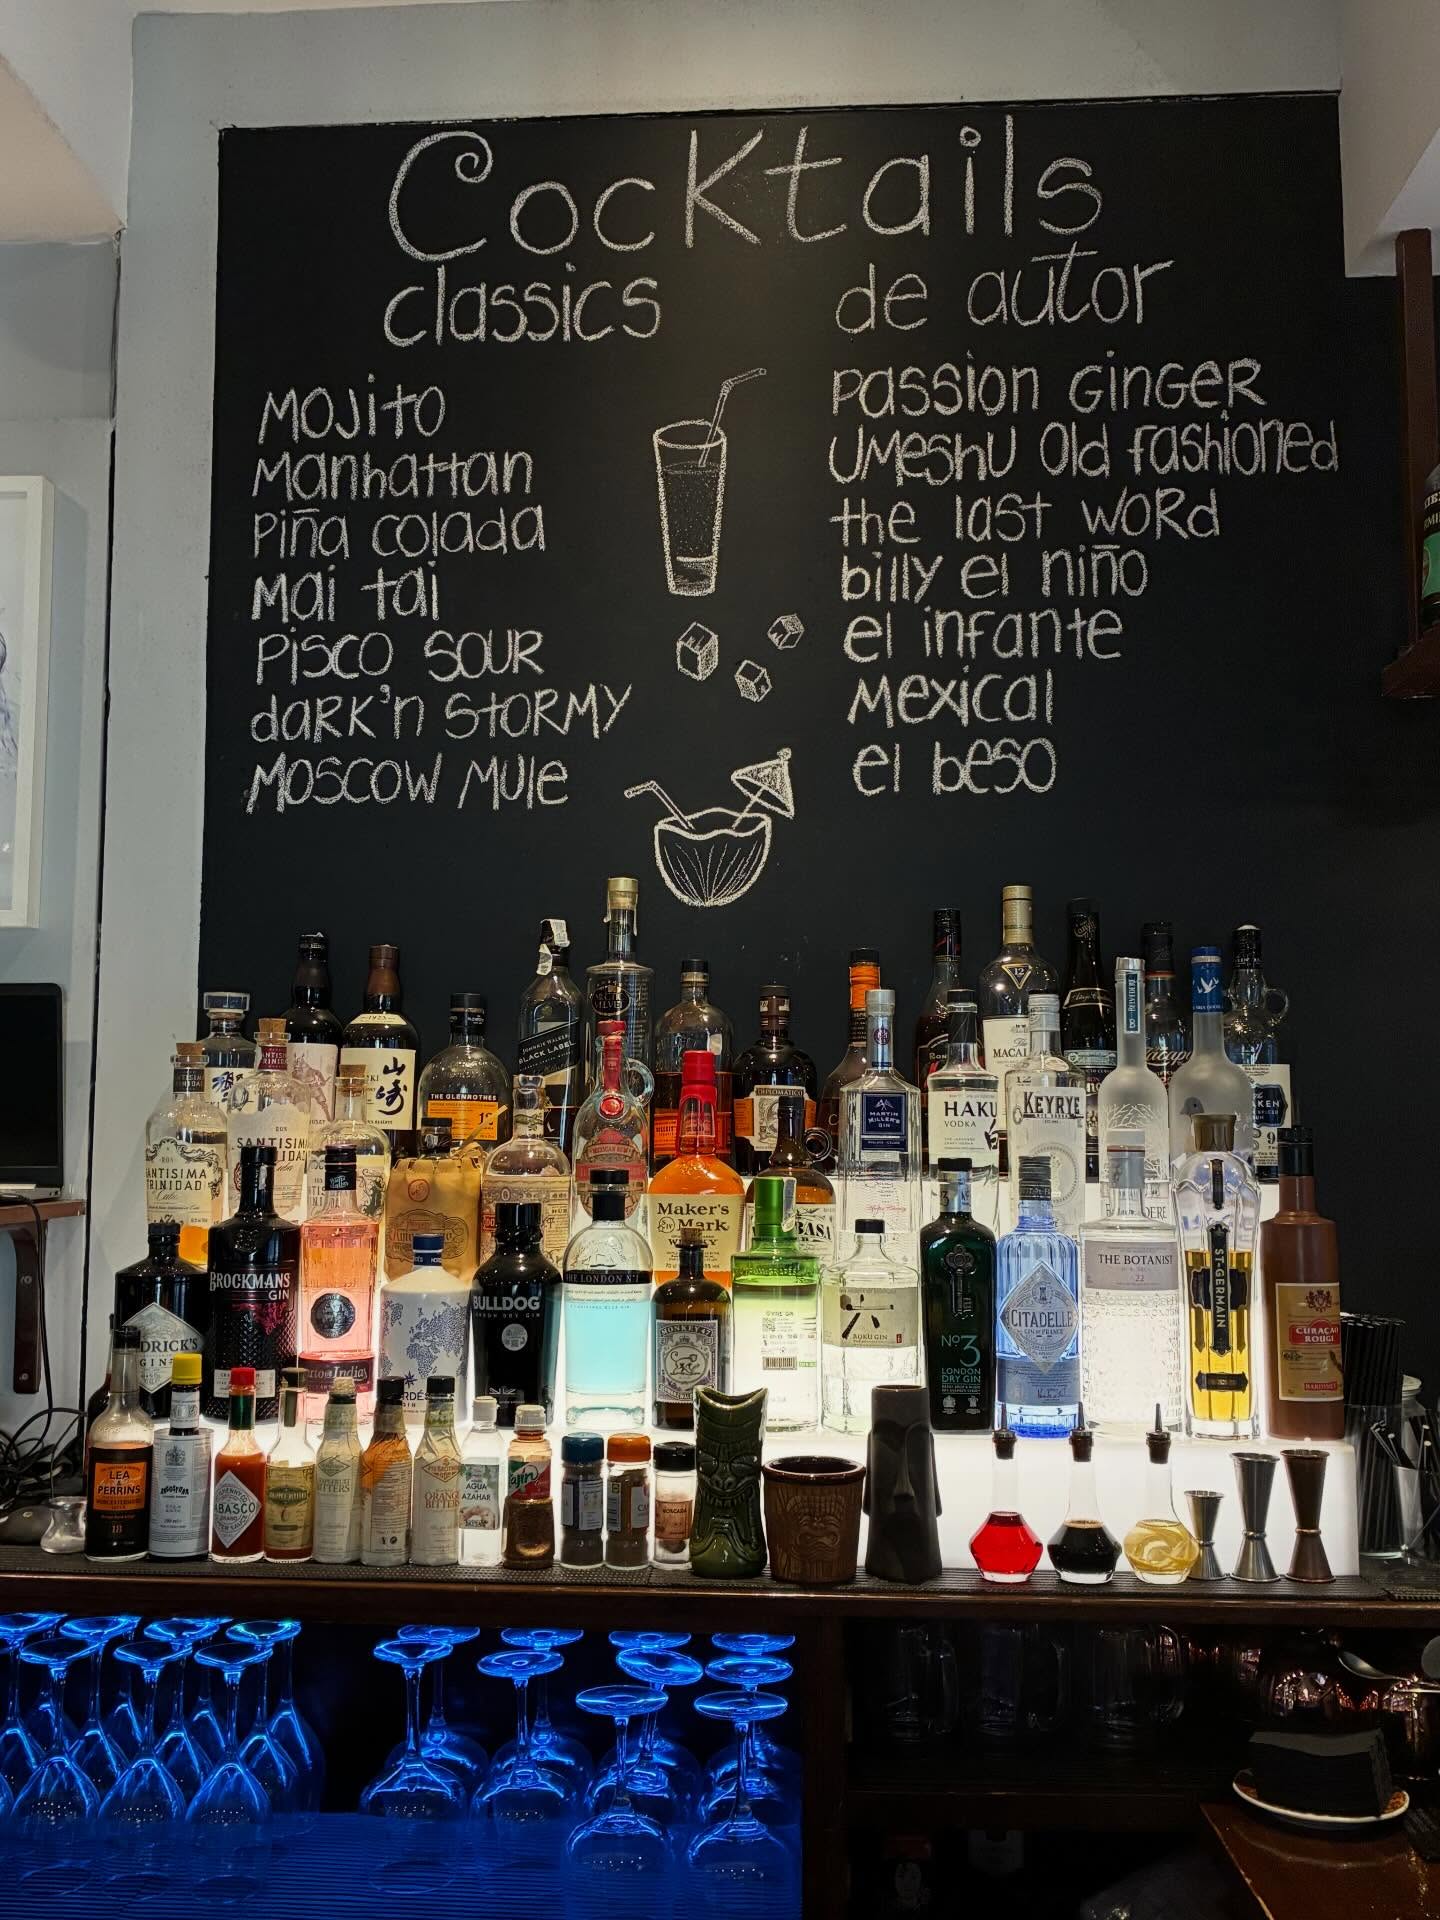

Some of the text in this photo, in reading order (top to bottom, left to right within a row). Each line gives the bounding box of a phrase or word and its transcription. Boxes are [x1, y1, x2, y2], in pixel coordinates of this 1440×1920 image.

[836, 241, 1175, 334] de autor
[829, 498, 920, 547] the
[956, 492, 1052, 542] last
[961, 552, 1009, 599] el
[360, 561, 439, 621] tai
[843, 606, 1123, 663] el infante
[852, 743, 900, 797] el
[518, 1040, 575, 1064] BLACK LABEL
[446, 1093, 498, 1102] GLENROTHES
[1023, 1091, 1080, 1115] KEYRYE
[944, 1101, 997, 1118] HAKU
[657, 1202, 730, 1215] Maker's
[678, 1219, 730, 1232] Mark
[1098, 1254, 1173, 1265] THE BOTANIST
[209, 1271, 291, 1291] BROCKMANS
[579, 1275, 623, 1283] LONDON
[268, 1289, 290, 1300] GIN
[1214, 1248, 1227, 1328] ST-GERMAIN
[472, 1296, 541, 1311] BULLDOG
[1010, 1309, 1073, 1328] CITADELLE
[140, 1337, 199, 1353] DRICK'S
[139, 1358, 167, 1367] GIN
[941, 1367, 981, 1376] LONDON
[941, 1375, 981, 1384] DRY GIN
[109, 1470, 130, 1480] LEA
[97, 1485, 141, 1495] PERRINS
[465, 1482, 488, 1491] AGUA
[461, 1491, 492, 1501] AZAHAR
